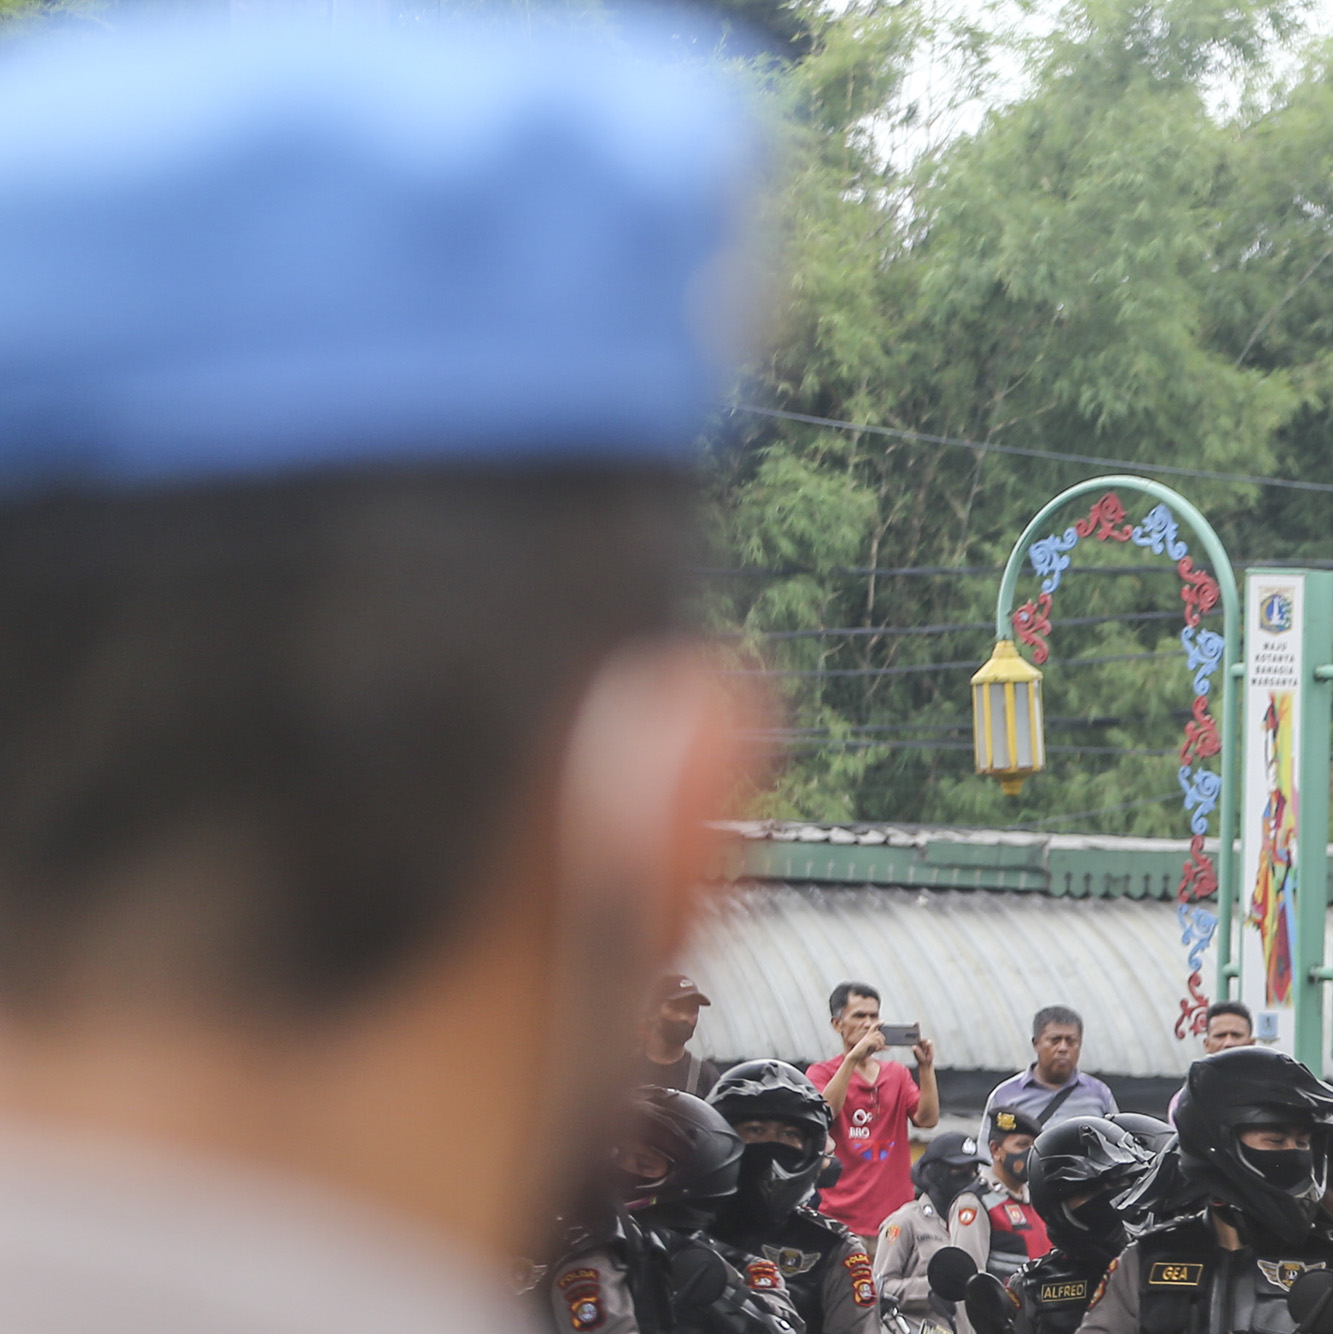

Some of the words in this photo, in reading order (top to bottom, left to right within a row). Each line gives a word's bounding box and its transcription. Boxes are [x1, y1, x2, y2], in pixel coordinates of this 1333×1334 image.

[849, 1126, 870, 1139] BRO
[1162, 1266, 1188, 1281] GEA
[1044, 1284, 1084, 1299] ALFRED
